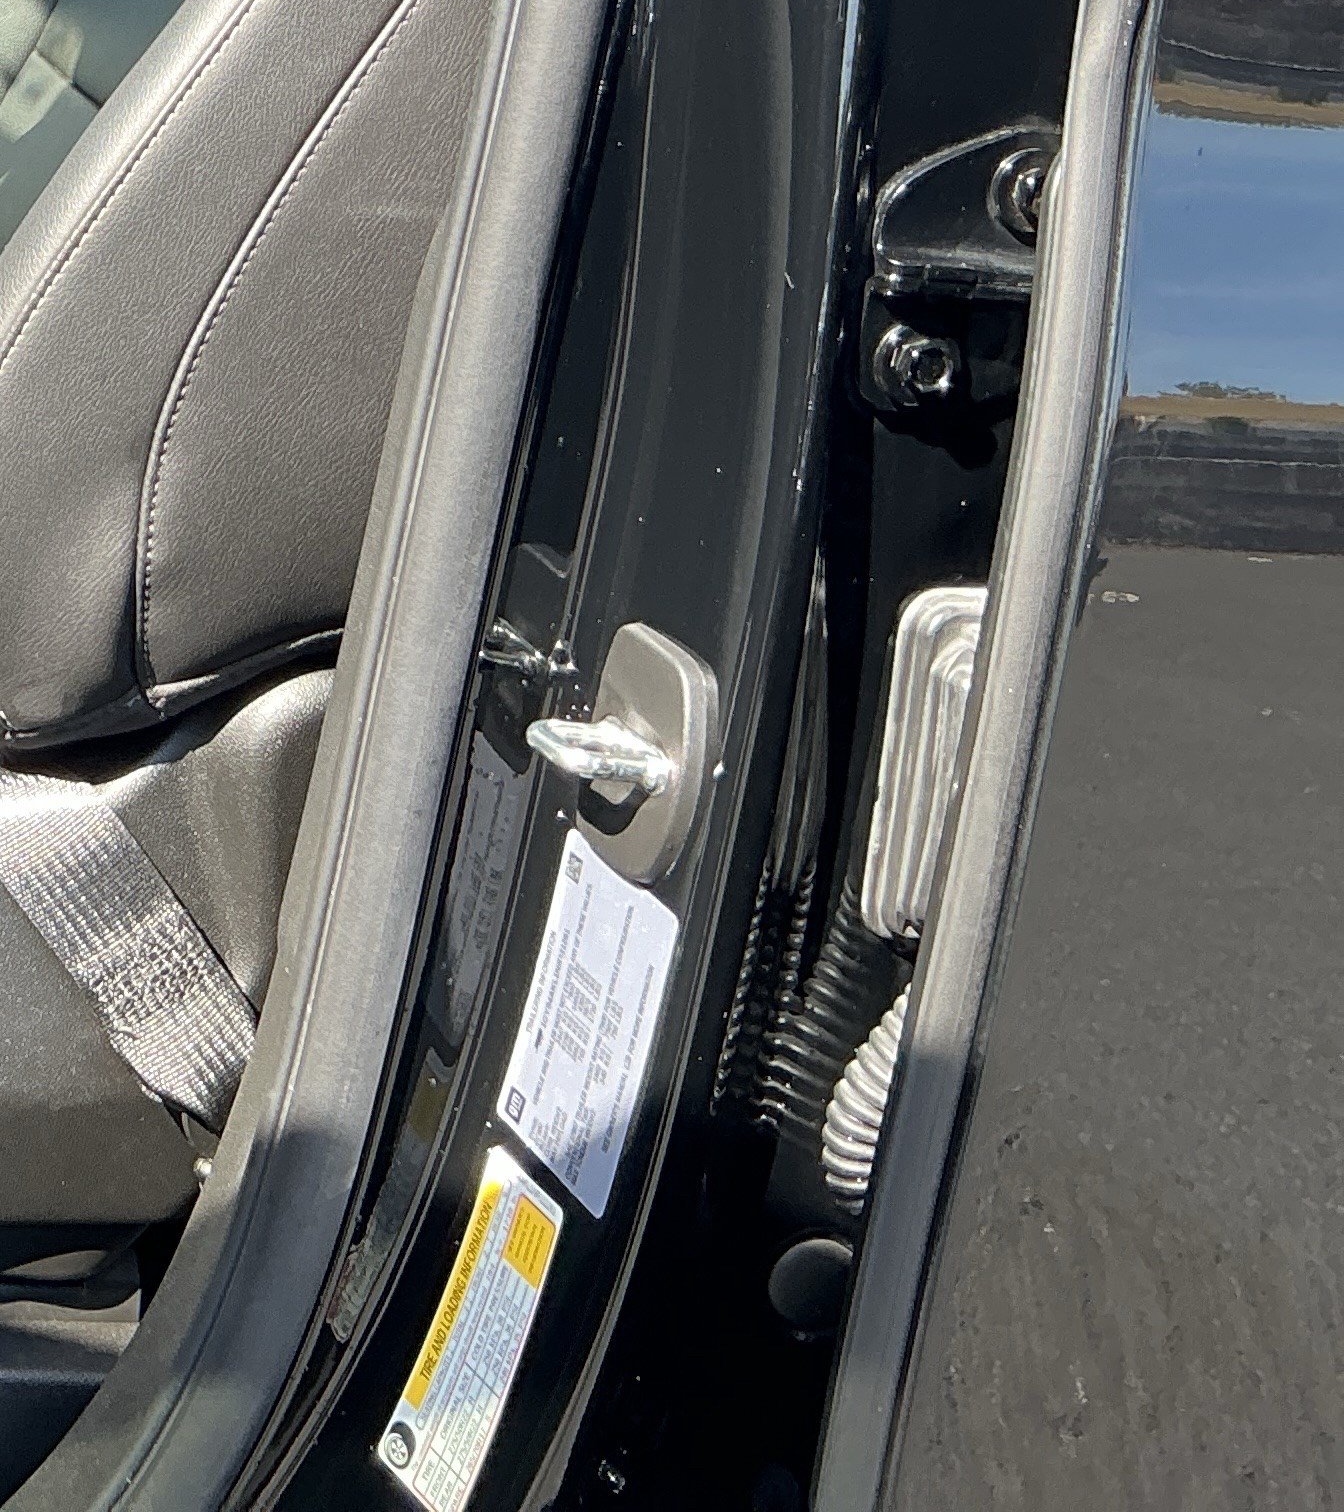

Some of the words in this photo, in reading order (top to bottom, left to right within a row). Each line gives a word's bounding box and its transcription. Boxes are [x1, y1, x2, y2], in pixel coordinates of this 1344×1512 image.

[418, 1351, 438, 1382] TIRE
[428, 1324, 448, 1357] AND
[439, 1274, 467, 1331] LOADING
[458, 1198, 493, 1281] INFORMATION
